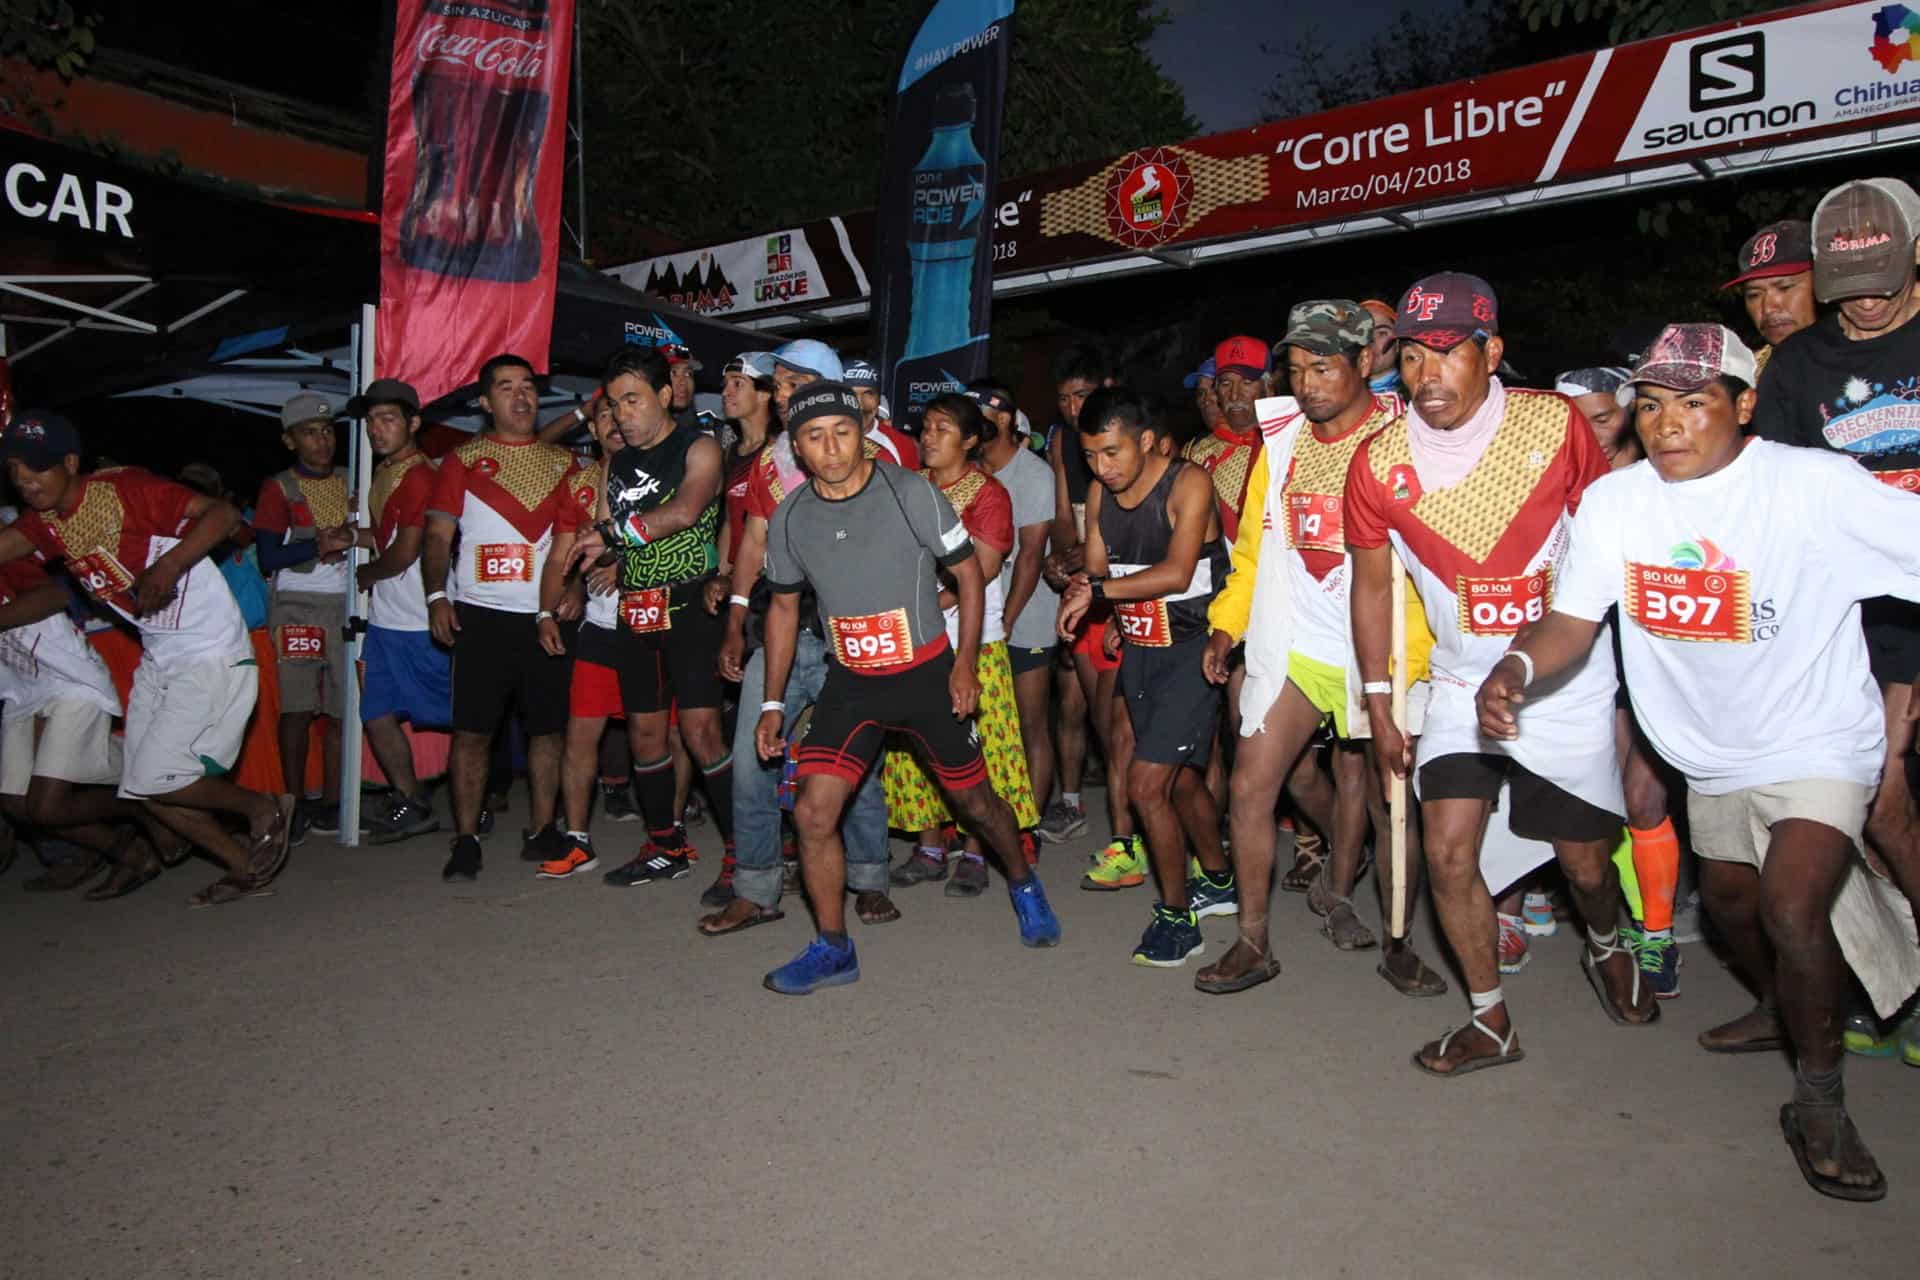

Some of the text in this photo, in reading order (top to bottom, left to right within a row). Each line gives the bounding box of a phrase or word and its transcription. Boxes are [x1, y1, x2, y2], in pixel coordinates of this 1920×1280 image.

[952, 25, 1000, 59] POWER
[913, 182, 984, 206] POWER
[1295, 158, 1472, 209] Marzo/04/2018
[5, 162, 135, 238] CAR
[1750, 232, 1778, 267] B
[624, 321, 674, 340] POWER
[909, 381, 960, 393] POWER
[487, 557, 525, 575] 829
[1491, 584, 1512, 593] KM
[1663, 573, 1687, 585] KM
[629, 606, 659, 625] 739
[1473, 596, 1543, 625] 068
[1645, 590, 1721, 626] 397
[287, 637, 321, 652] 259
[845, 632, 897, 658] 895
